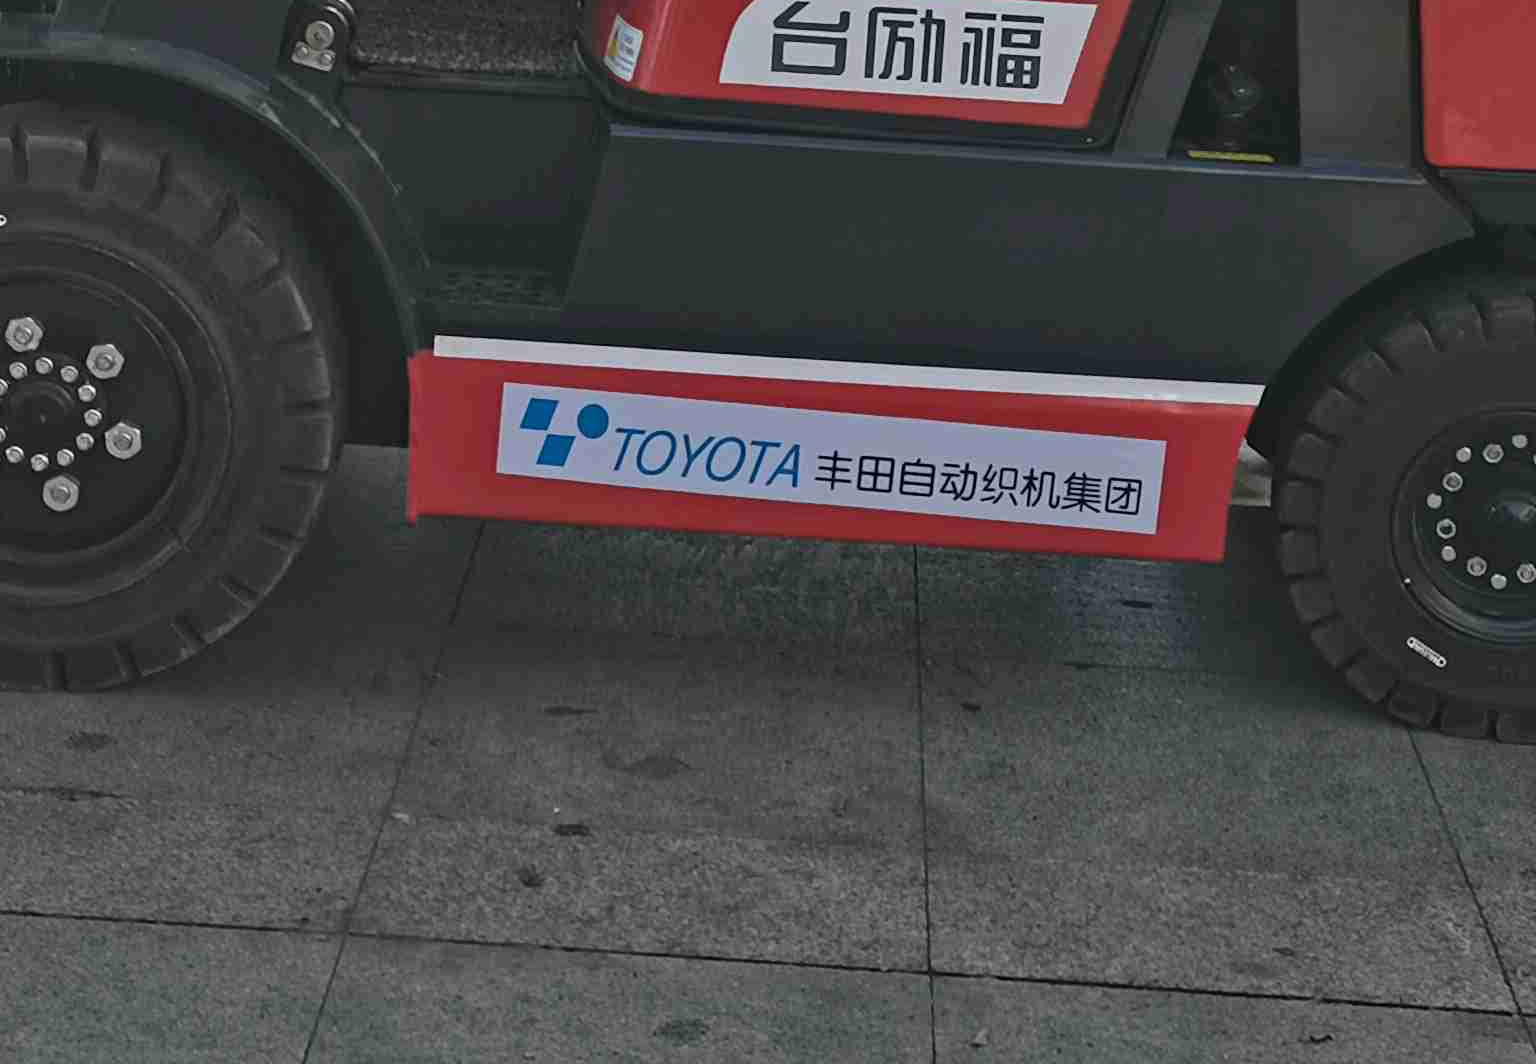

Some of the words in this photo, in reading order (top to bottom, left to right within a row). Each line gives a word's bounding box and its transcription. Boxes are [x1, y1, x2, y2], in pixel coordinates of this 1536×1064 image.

[770, 0, 1046, 90] 台励福
[612, 425, 802, 488] TOYOTA
[814, 449, 1143, 516] 丰田自动织机集团
